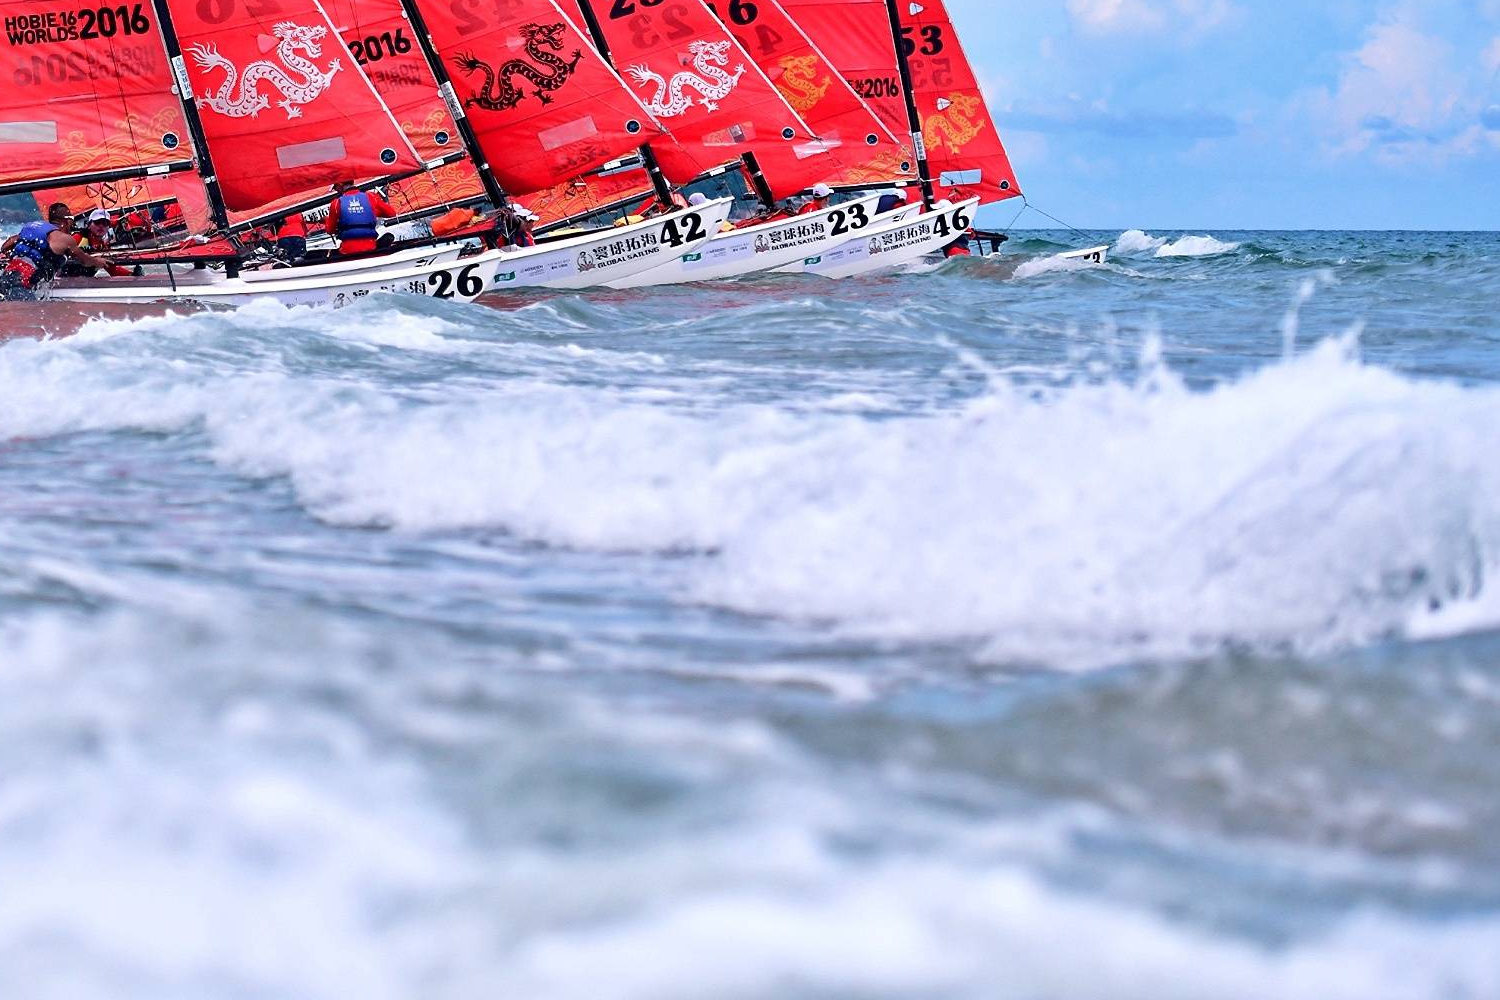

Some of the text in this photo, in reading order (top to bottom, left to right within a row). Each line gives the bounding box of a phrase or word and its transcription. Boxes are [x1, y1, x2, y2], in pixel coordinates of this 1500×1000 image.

[4, 10, 77, 32] HOBIE 16
[6, 3, 150, 46] WORLDS 2016
[347, 27, 412, 66] 2016
[864, 77, 899, 98] 2016
[660, 212, 706, 248] 42
[827, 203, 869, 237] 23
[933, 206, 970, 238] 46
[597, 246, 660, 269] GLOBAL SAILING
[771, 234, 827, 251] GLOBAL SAILING
[883, 235, 932, 253] GLOBAL SAILING
[428, 263, 484, 299] 26
